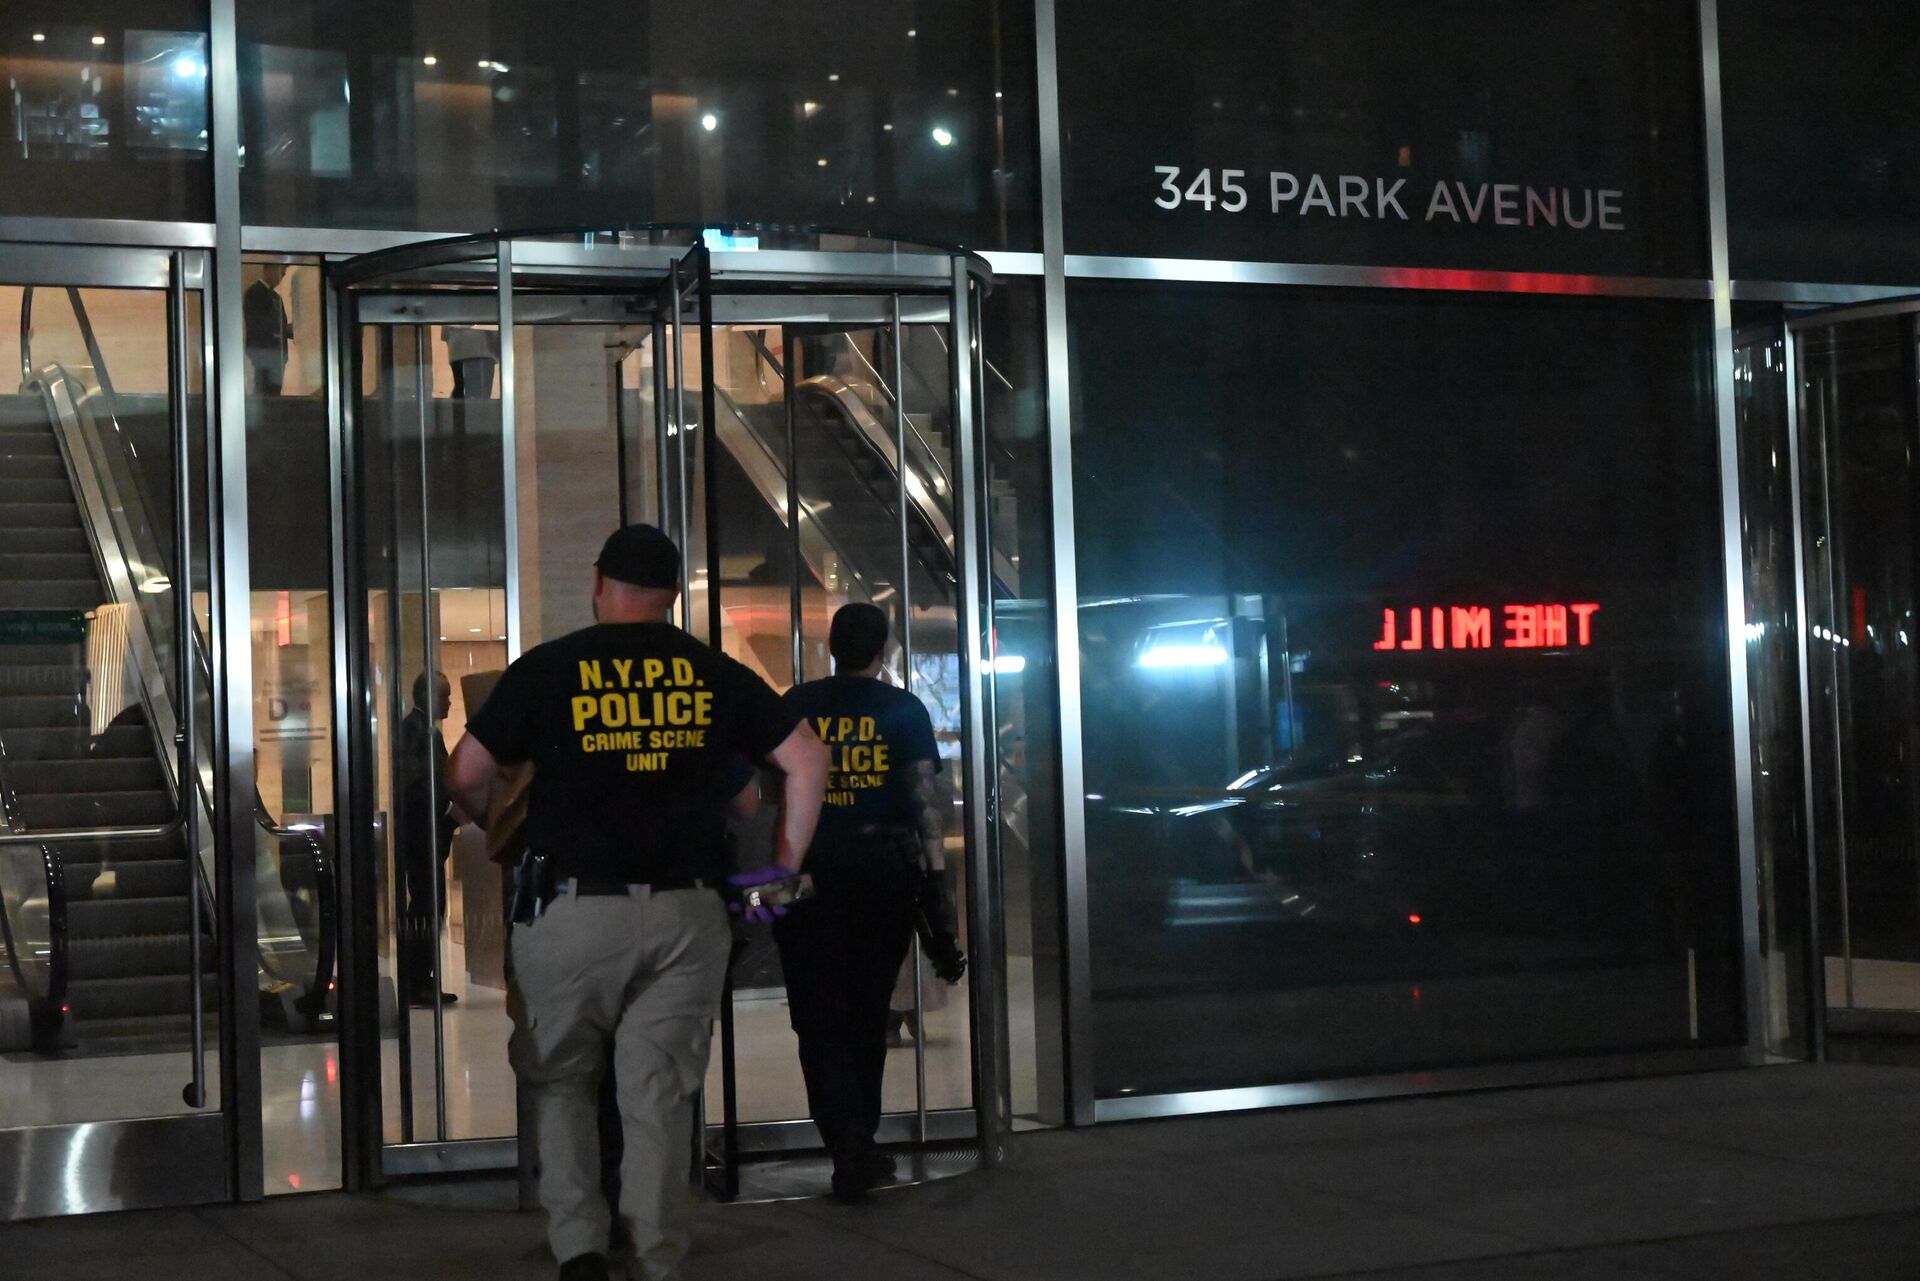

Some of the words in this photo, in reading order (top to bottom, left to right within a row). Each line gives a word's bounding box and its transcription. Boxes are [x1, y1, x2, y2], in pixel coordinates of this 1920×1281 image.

[1153, 165, 1248, 213] 345
[1269, 171, 1410, 220] PARK
[1424, 179, 1626, 231] AVENUE
[578, 657, 705, 691] N.Y.P.D.
[571, 691, 714, 732] POLICE
[582, 731, 642, 752] CRIME
[649, 729, 706, 749] SCENE
[816, 716, 883, 742] Y.P.D.
[625, 752, 669, 772] UNIT
